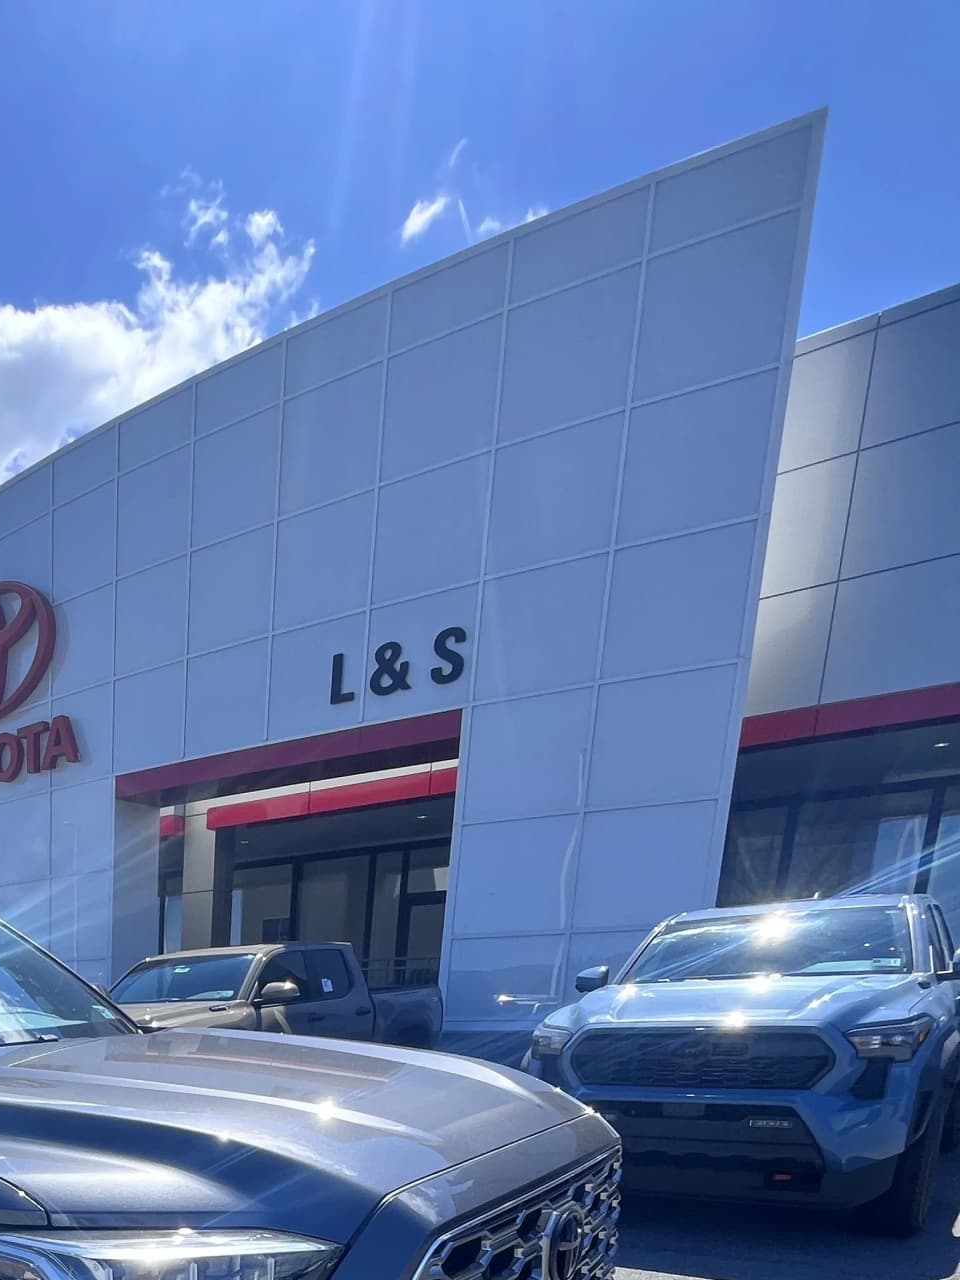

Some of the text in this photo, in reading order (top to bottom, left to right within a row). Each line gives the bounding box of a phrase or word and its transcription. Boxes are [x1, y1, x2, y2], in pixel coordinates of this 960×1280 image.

[330, 626, 467, 704] L & S
